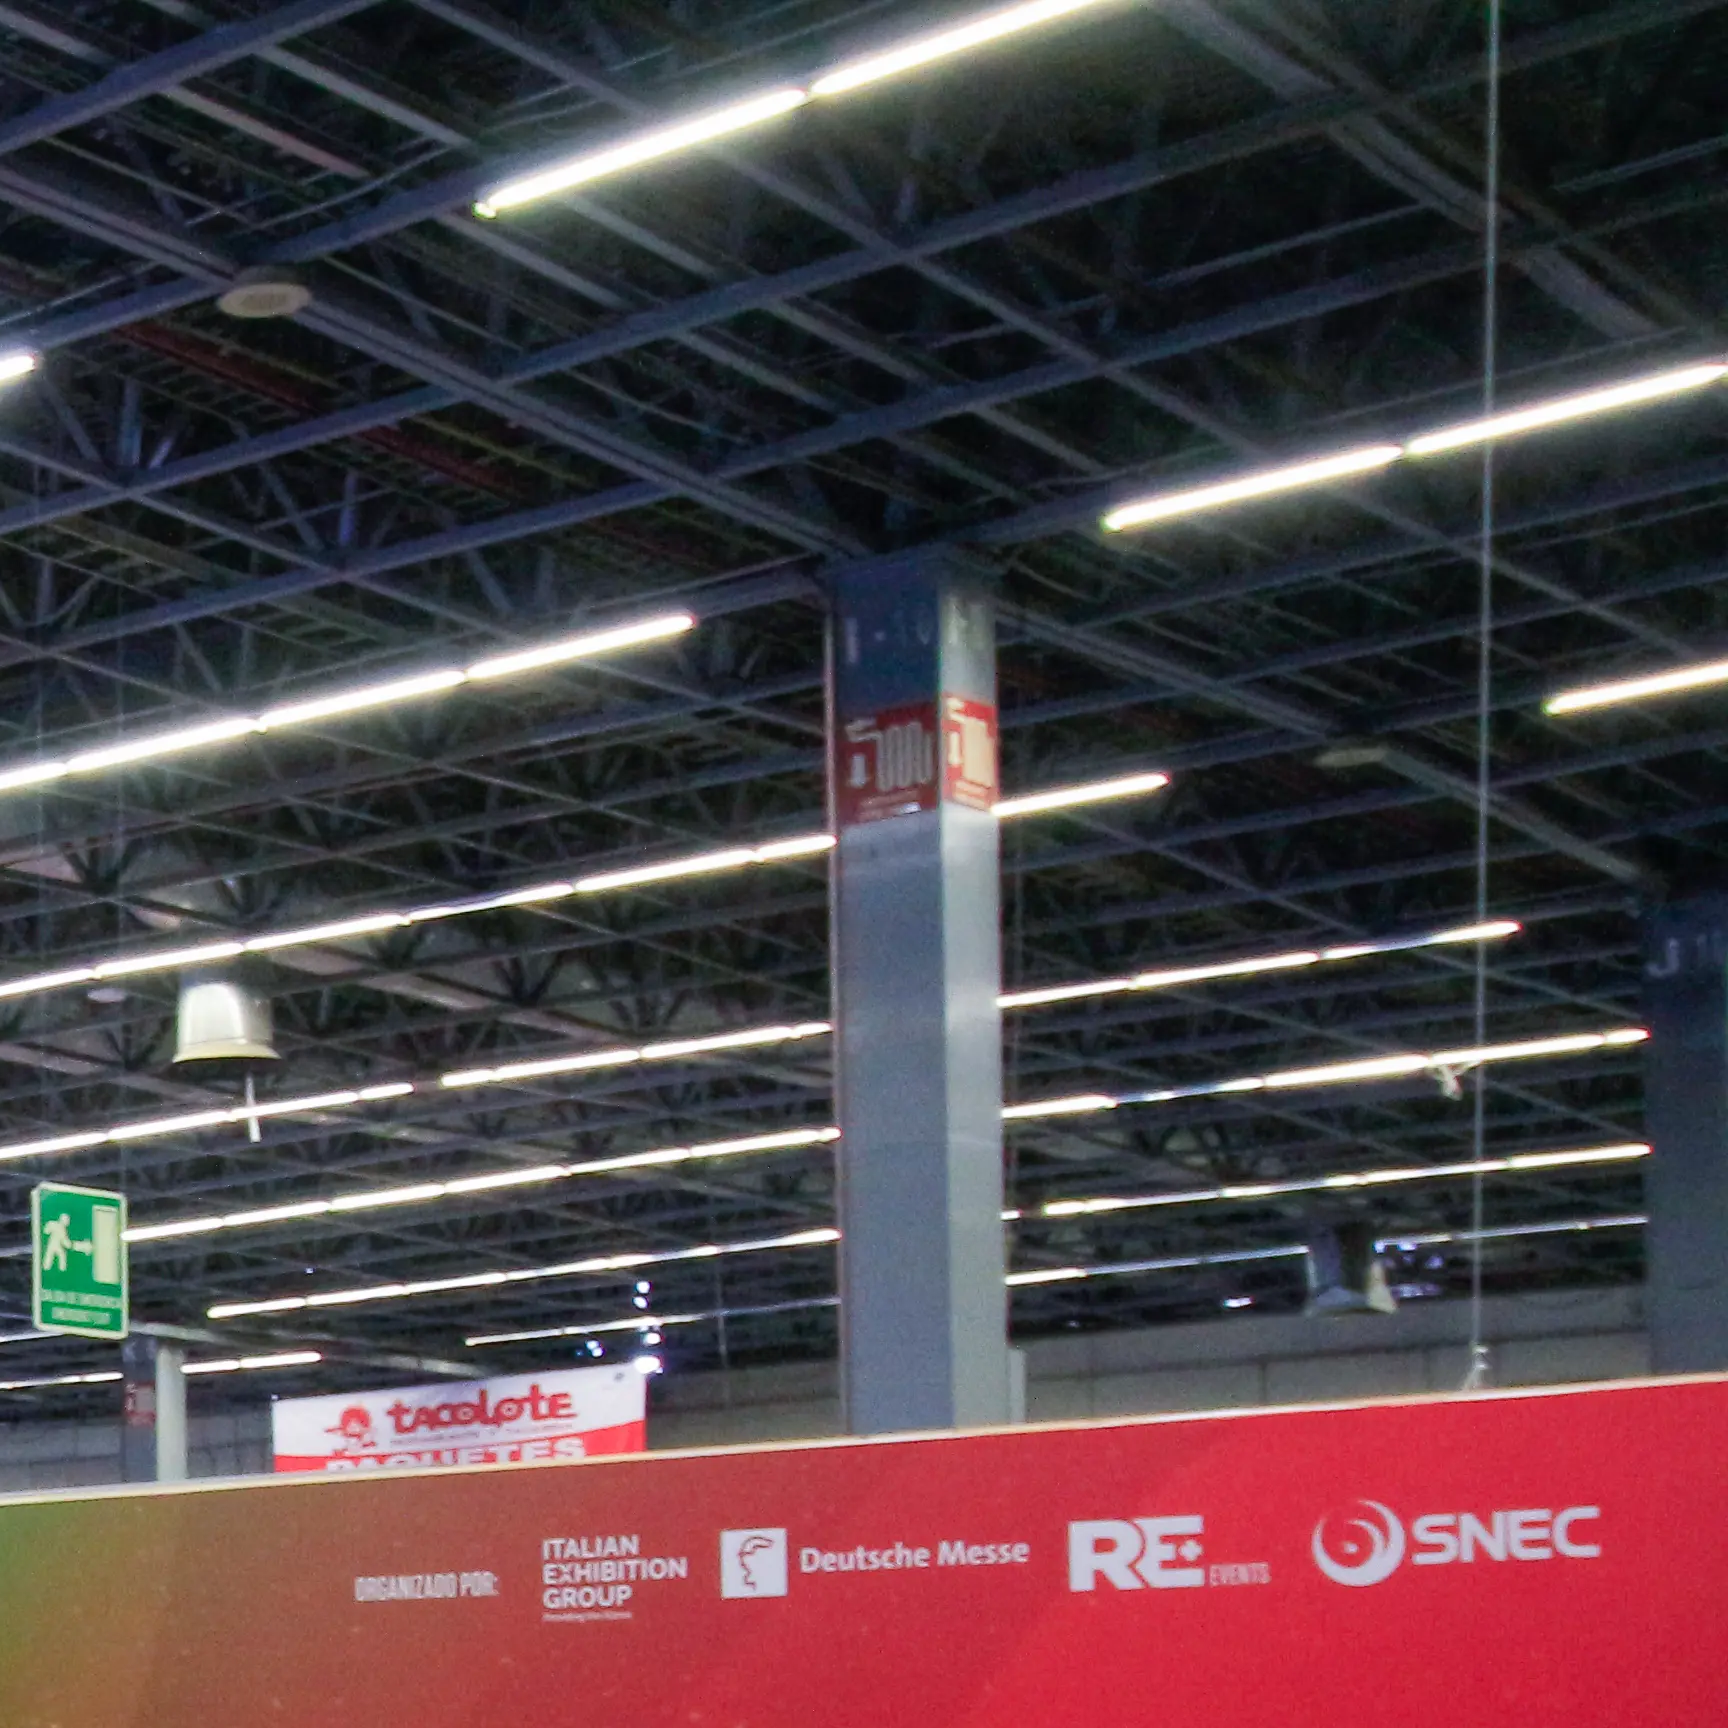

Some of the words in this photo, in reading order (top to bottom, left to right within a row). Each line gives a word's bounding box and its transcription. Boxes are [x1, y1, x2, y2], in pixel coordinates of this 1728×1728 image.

[542, 1534, 640, 1560] ITALIAN
[1411, 1505, 1602, 1566] SNEC
[542, 1556, 689, 1585] EXHIBITION
[799, 1541, 931, 1574] Deutsche
[936, 1538, 1030, 1566] Messe
[542, 1583, 633, 1609] GROUP
